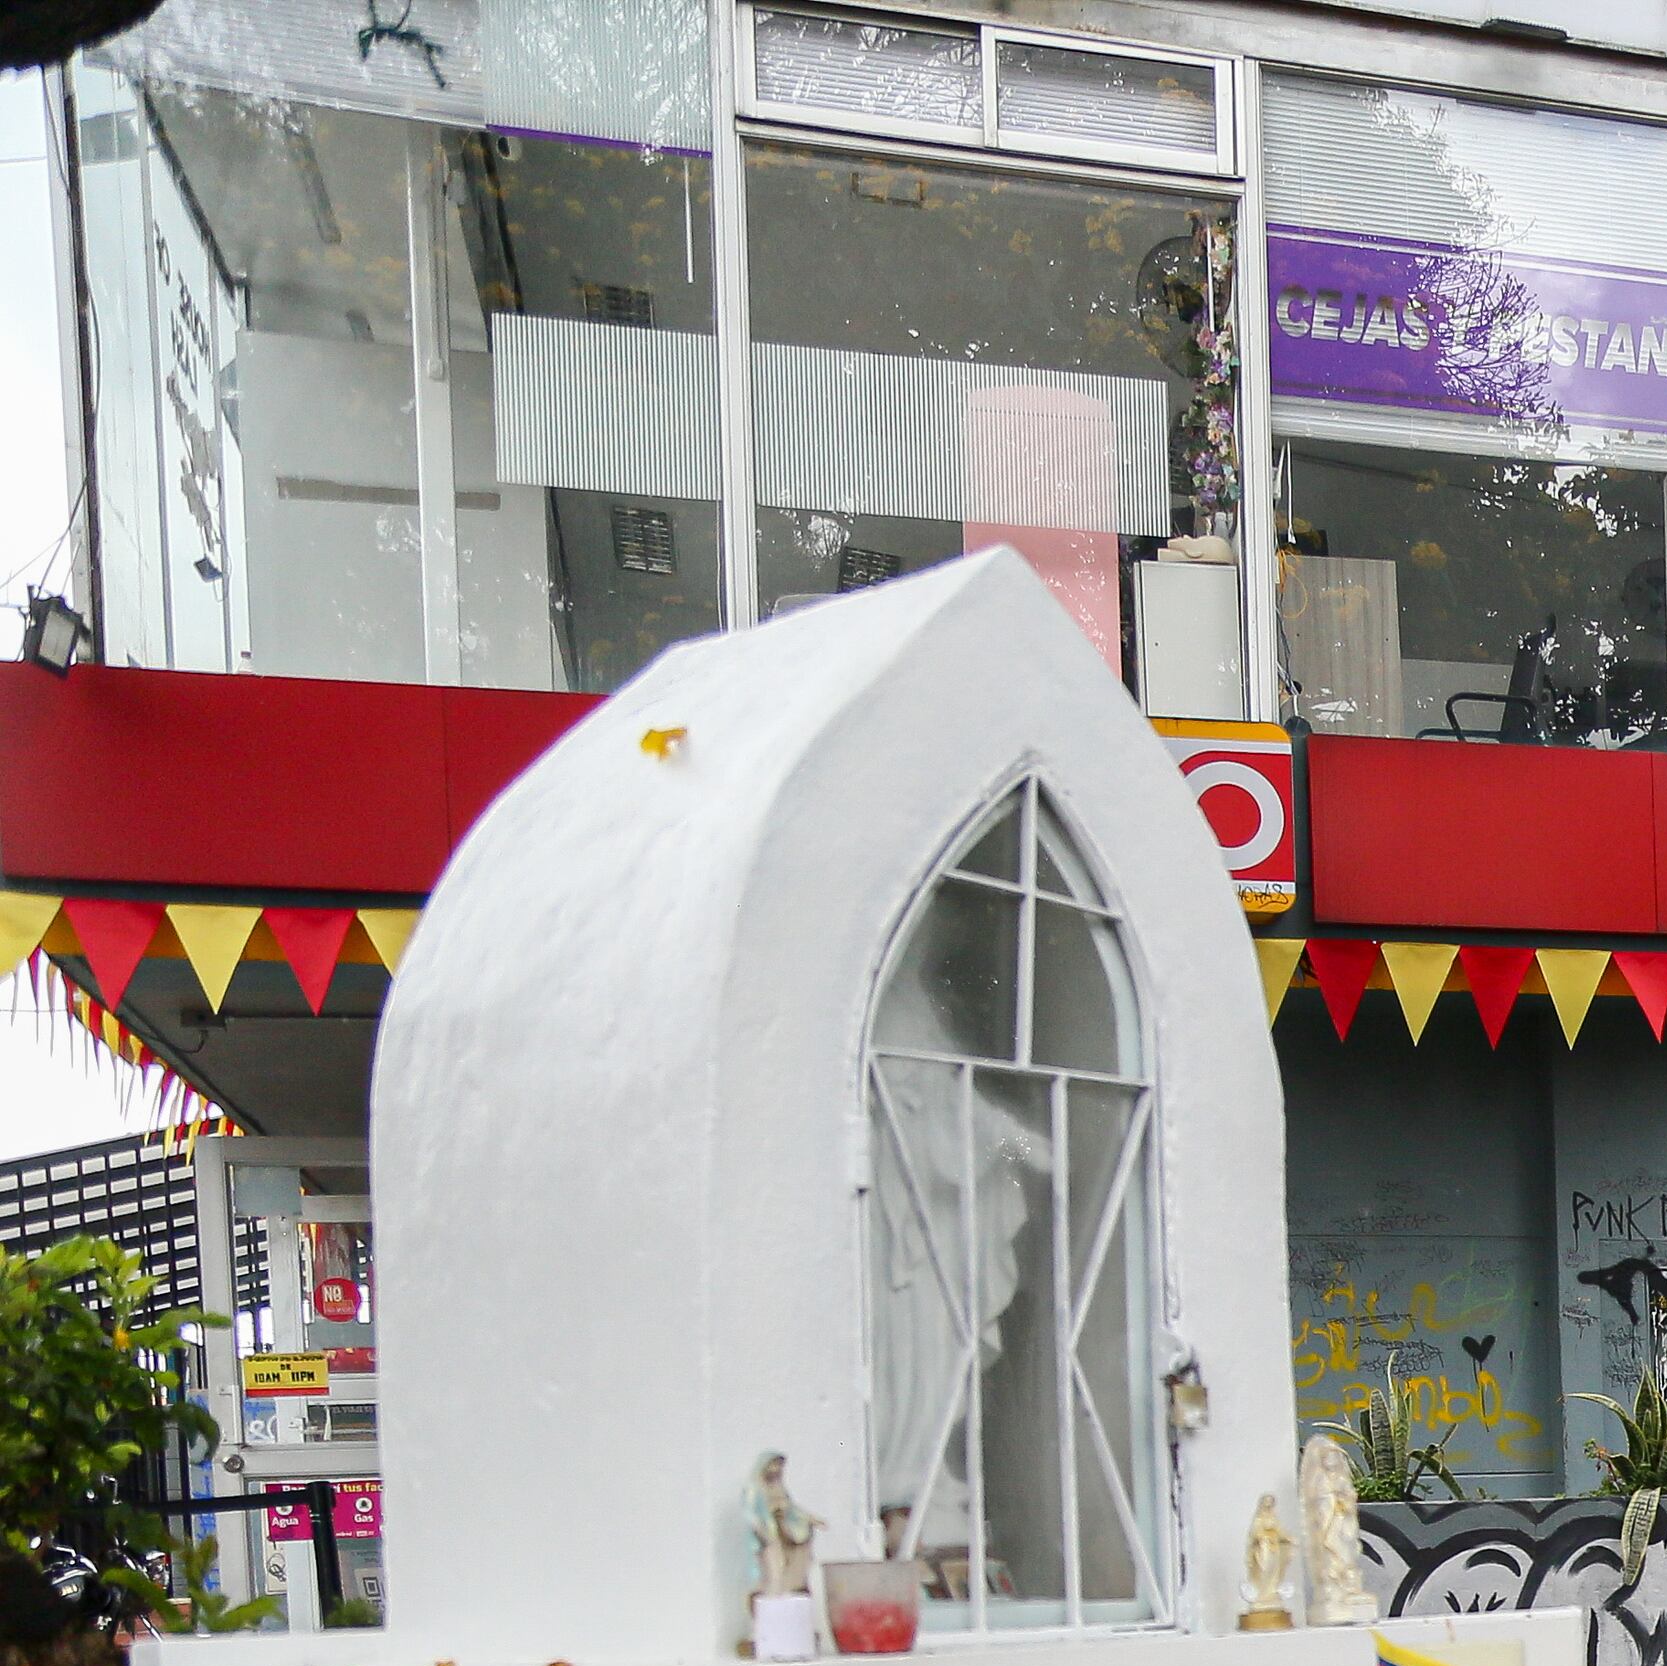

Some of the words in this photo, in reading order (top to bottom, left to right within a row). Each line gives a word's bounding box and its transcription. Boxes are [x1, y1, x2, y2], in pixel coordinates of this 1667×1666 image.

[1275, 286, 1430, 351] CEJAS
[343, 1483, 362, 1492] tus
[271, 1517, 299, 1528] Agua
[354, 1514, 374, 1522] Gas
